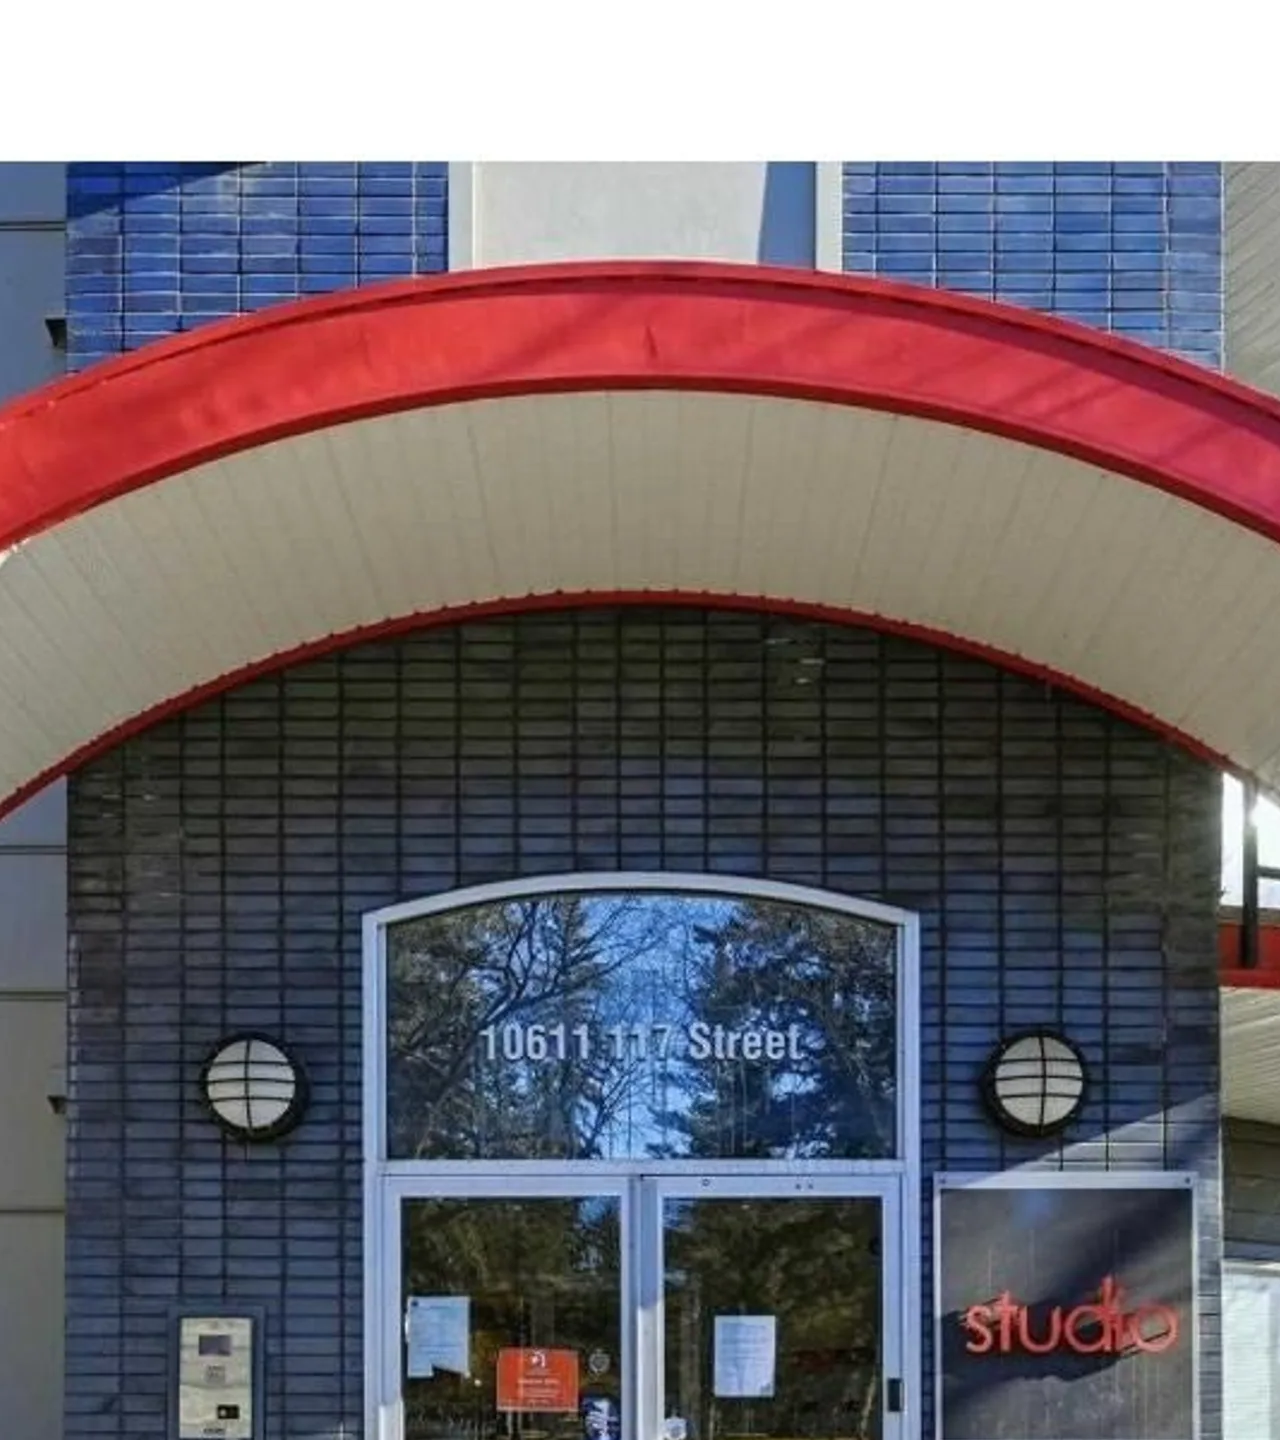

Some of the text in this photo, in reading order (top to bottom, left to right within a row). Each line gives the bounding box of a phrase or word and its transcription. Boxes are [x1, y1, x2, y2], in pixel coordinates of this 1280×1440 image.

[480, 1022, 804, 1061] 10611 117 Street
[965, 1274, 1179, 1354] studio
